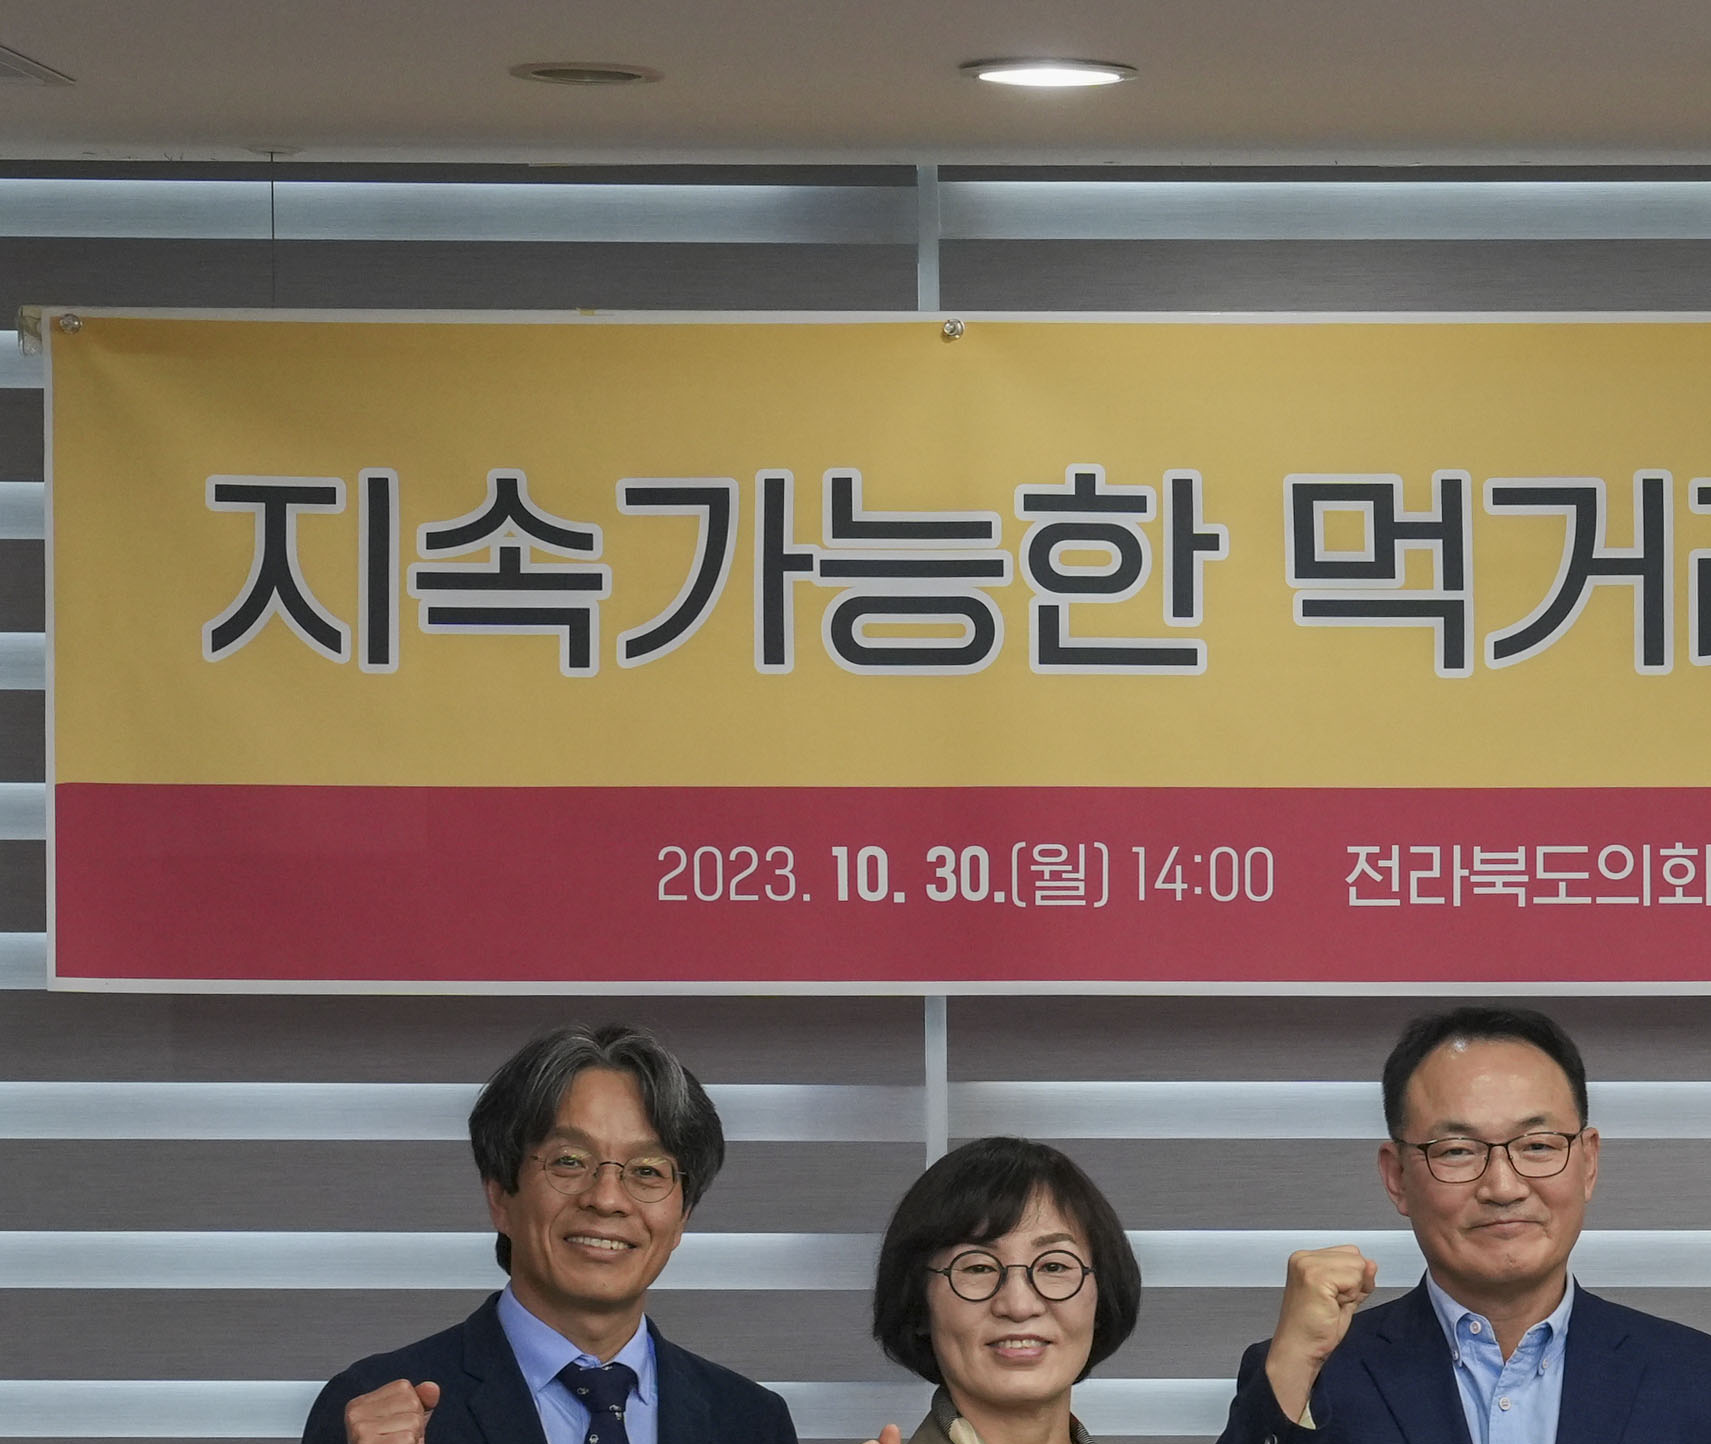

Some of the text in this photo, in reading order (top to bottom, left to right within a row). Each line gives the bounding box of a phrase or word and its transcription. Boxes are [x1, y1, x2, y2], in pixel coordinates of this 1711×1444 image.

[210, 472, 1221, 670] 지속가능한
[657, 840, 1275, 909] 2023. 10. 30.(월) 14:00
